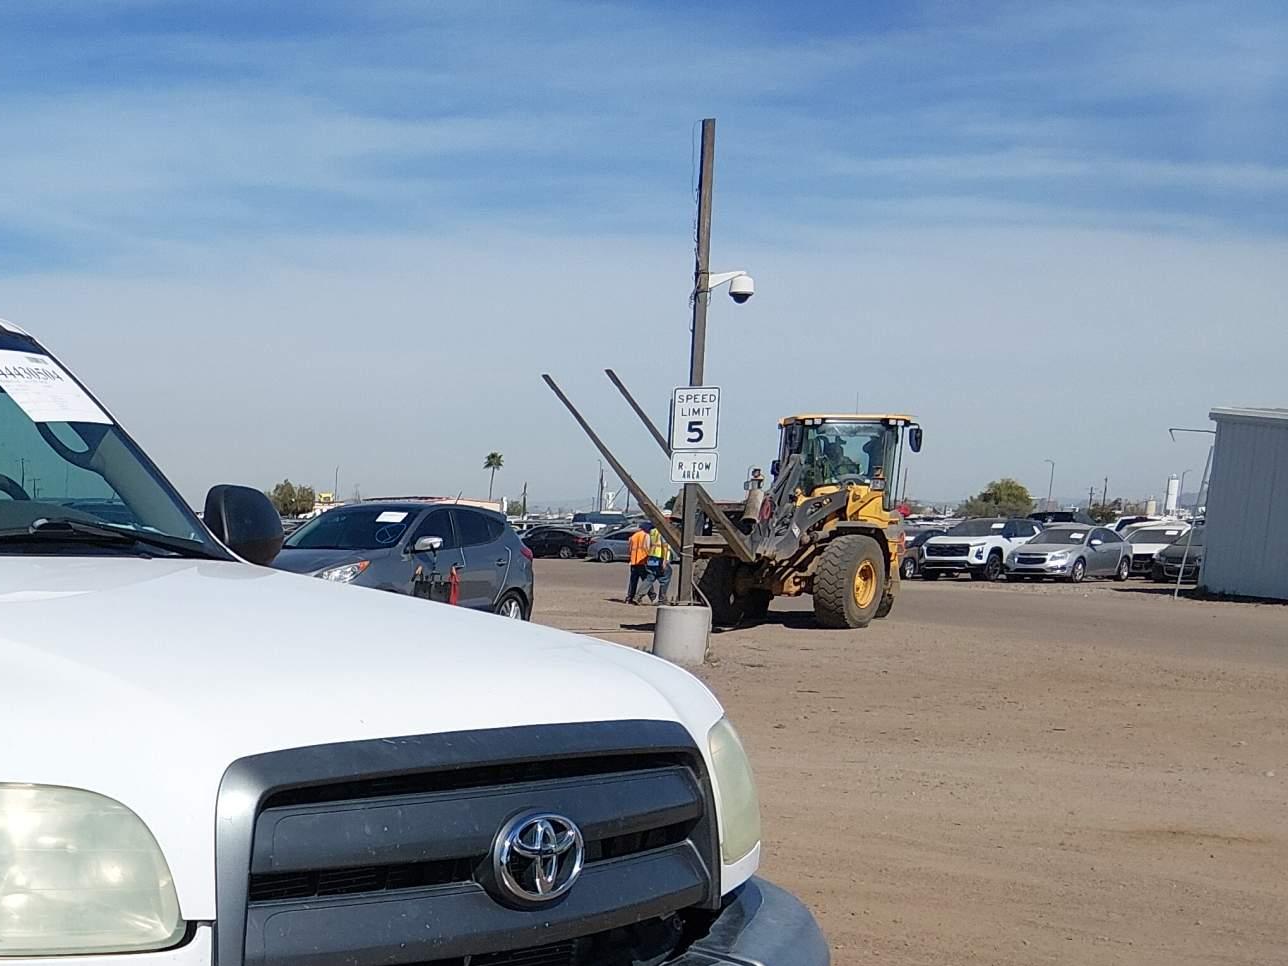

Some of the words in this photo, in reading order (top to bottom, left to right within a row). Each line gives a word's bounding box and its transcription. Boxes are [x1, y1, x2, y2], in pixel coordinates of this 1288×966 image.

[678, 394, 717, 403] SPEED
[681, 407, 711, 416] LIMIT
[687, 421, 704, 443] 5
[693, 462, 711, 472] TOW
[682, 471, 700, 479] AREA
